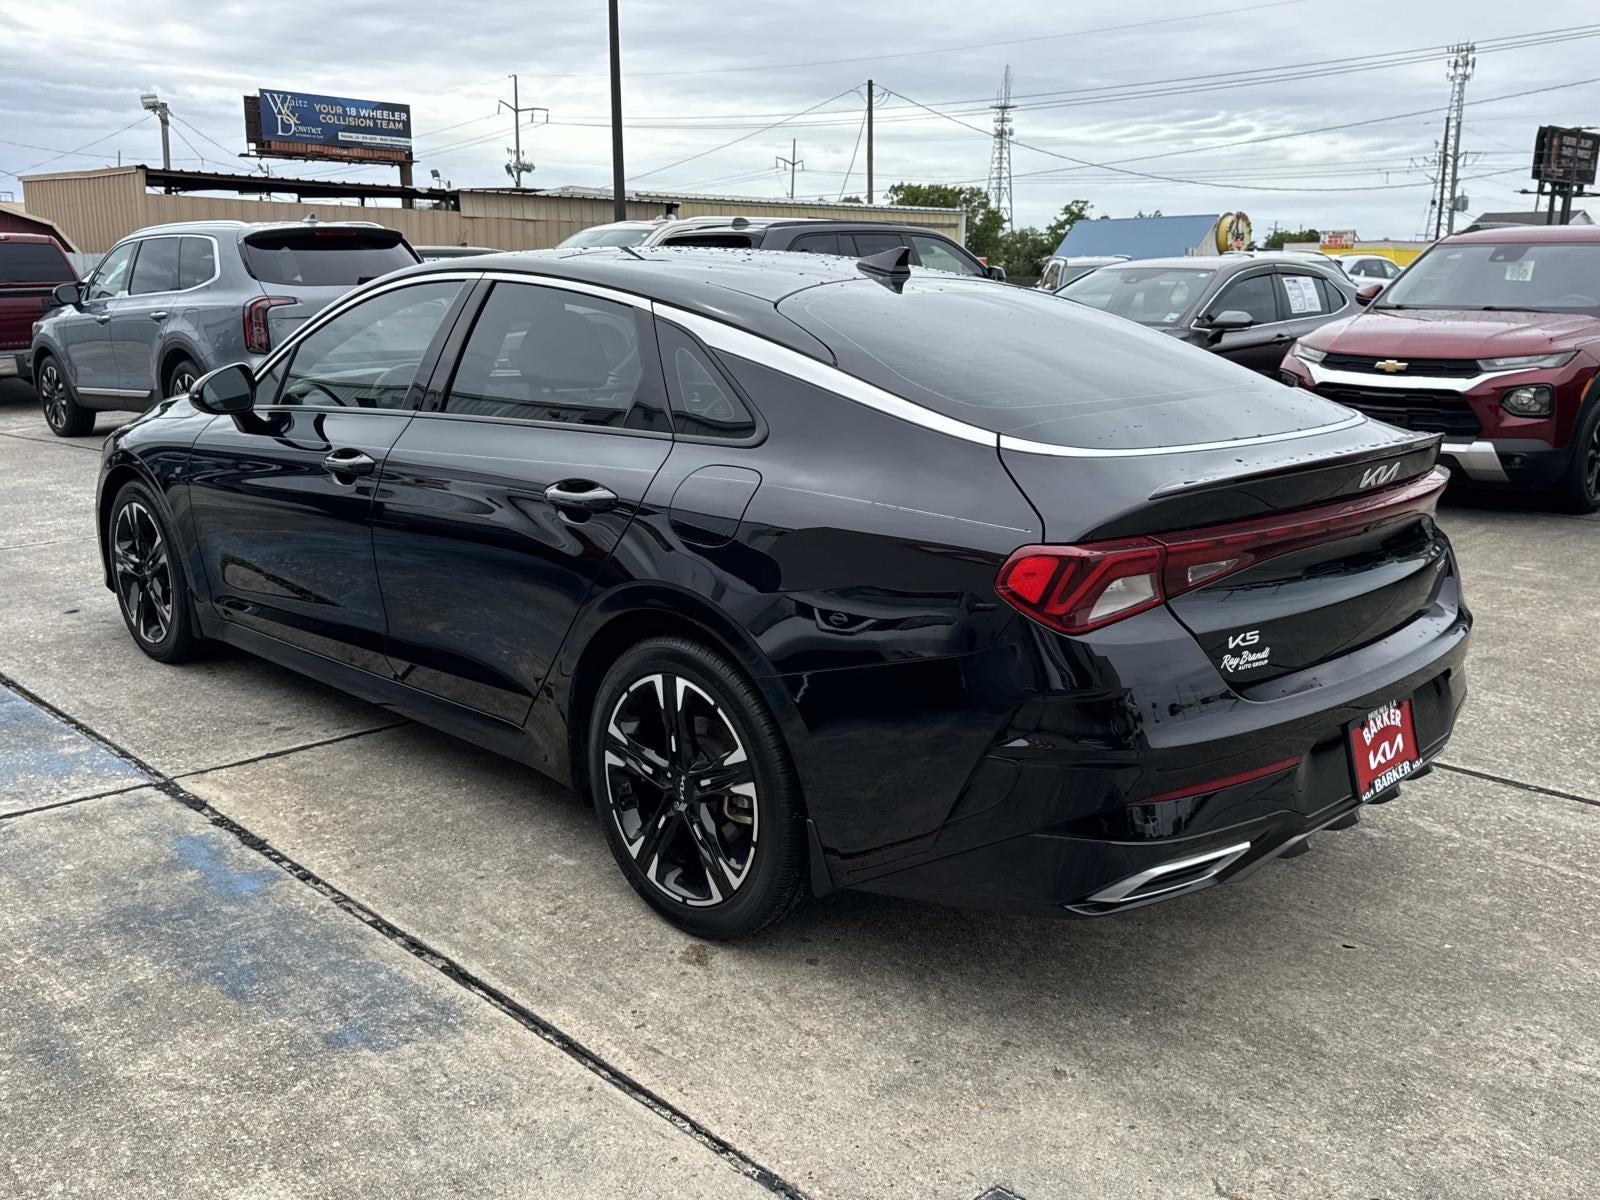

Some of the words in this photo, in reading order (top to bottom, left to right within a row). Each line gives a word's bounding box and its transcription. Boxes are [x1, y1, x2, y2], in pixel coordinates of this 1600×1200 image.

[264, 92, 308, 115] Waitz
[314, 103, 343, 115] YOUR
[345, 106, 357, 116] 18
[359, 108, 407, 121] WHEELER
[275, 114, 322, 136] Downer
[319, 114, 374, 128] COLLISION
[376, 120, 404, 130] TEAM
[1228, 630, 1260, 649] K5
[1220, 654, 1240, 673] Ray
[1239, 646, 1271, 665] Brandt
[1238, 662, 1252, 671] AUTO
[1252, 659, 1269, 668] GROUP
[1362, 708, 1402, 747] BARKER
[1374, 760, 1411, 793] BARKER
